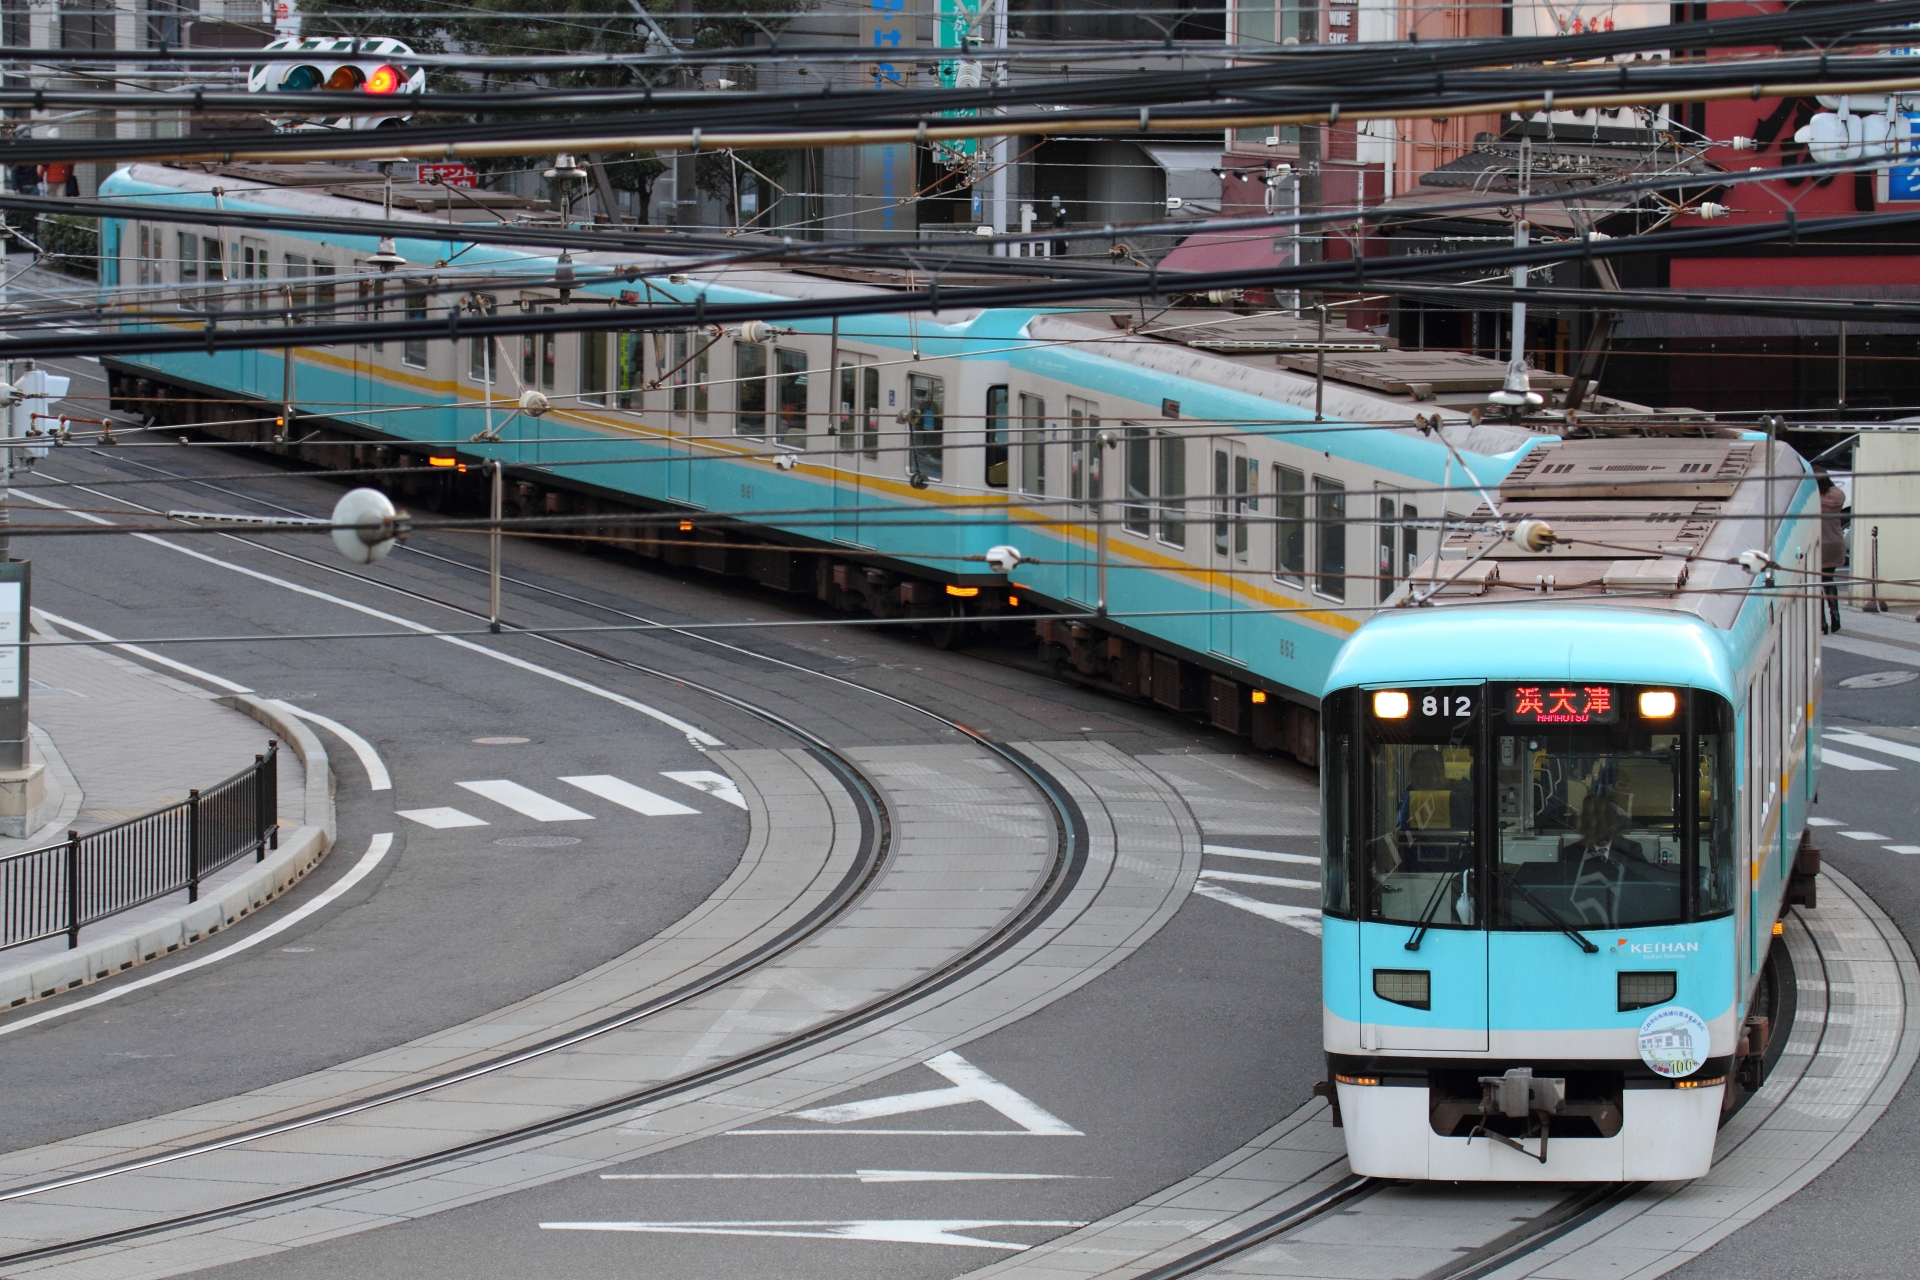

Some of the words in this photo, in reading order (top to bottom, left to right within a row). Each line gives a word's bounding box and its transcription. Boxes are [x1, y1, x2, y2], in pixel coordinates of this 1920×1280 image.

[1329, 10, 1351, 26] WINE
[1280, 638, 1294, 659] 862
[1422, 696, 1471, 716] 812
[1515, 687, 1611, 714] 浜大津
[1630, 942, 1699, 954] KEIHAN
